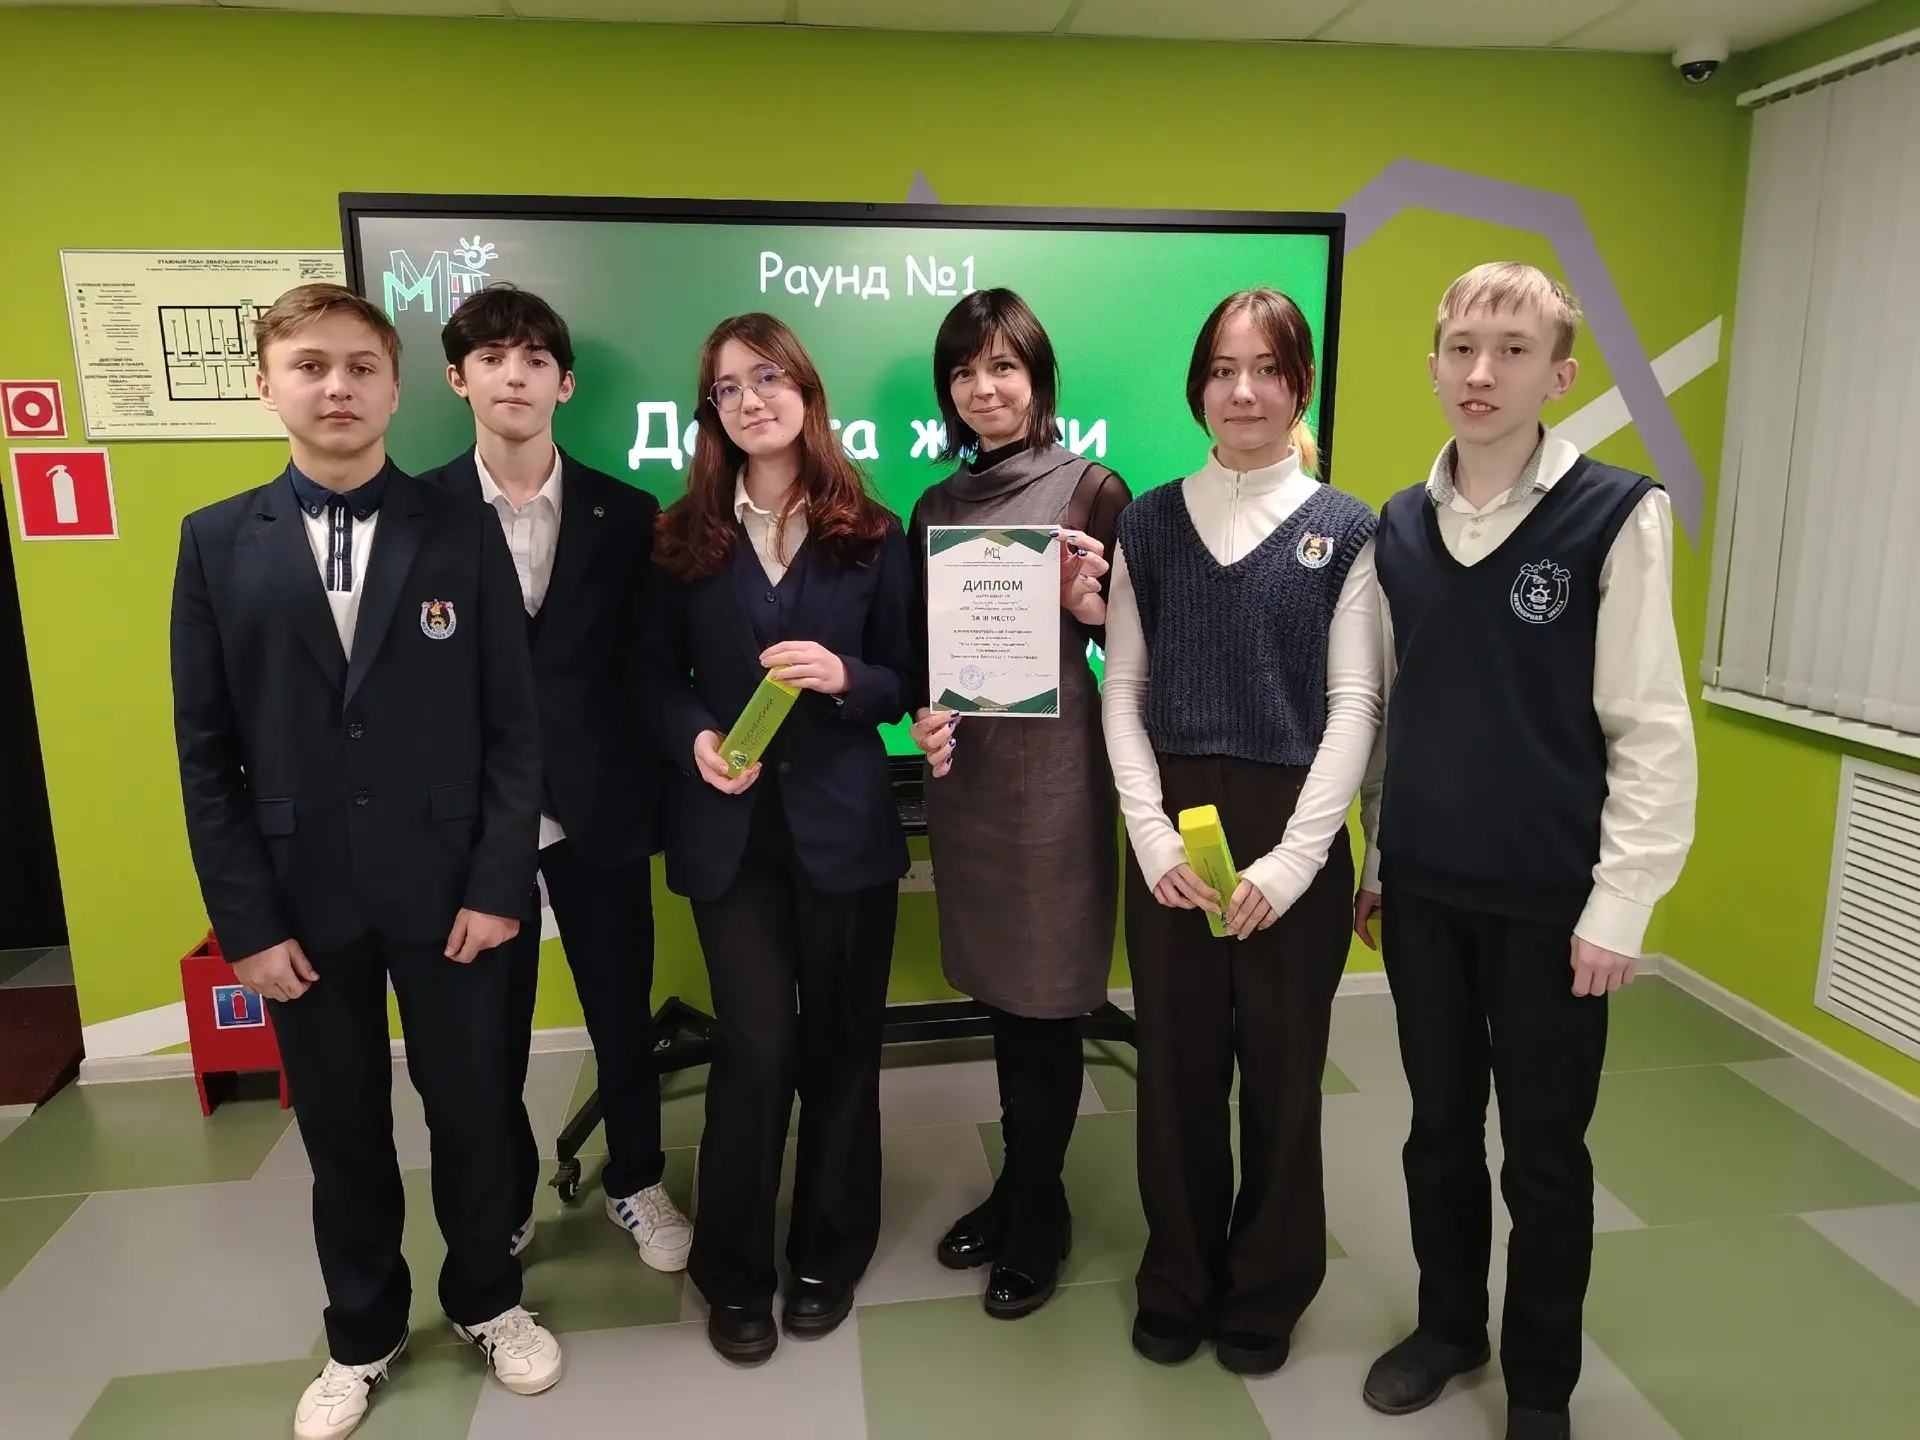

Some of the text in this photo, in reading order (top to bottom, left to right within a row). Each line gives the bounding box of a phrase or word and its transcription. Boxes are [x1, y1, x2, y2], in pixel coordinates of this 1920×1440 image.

[759, 251, 976, 308] Раунд №1
[962, 580, 1023, 592] ДИПЛОМ
